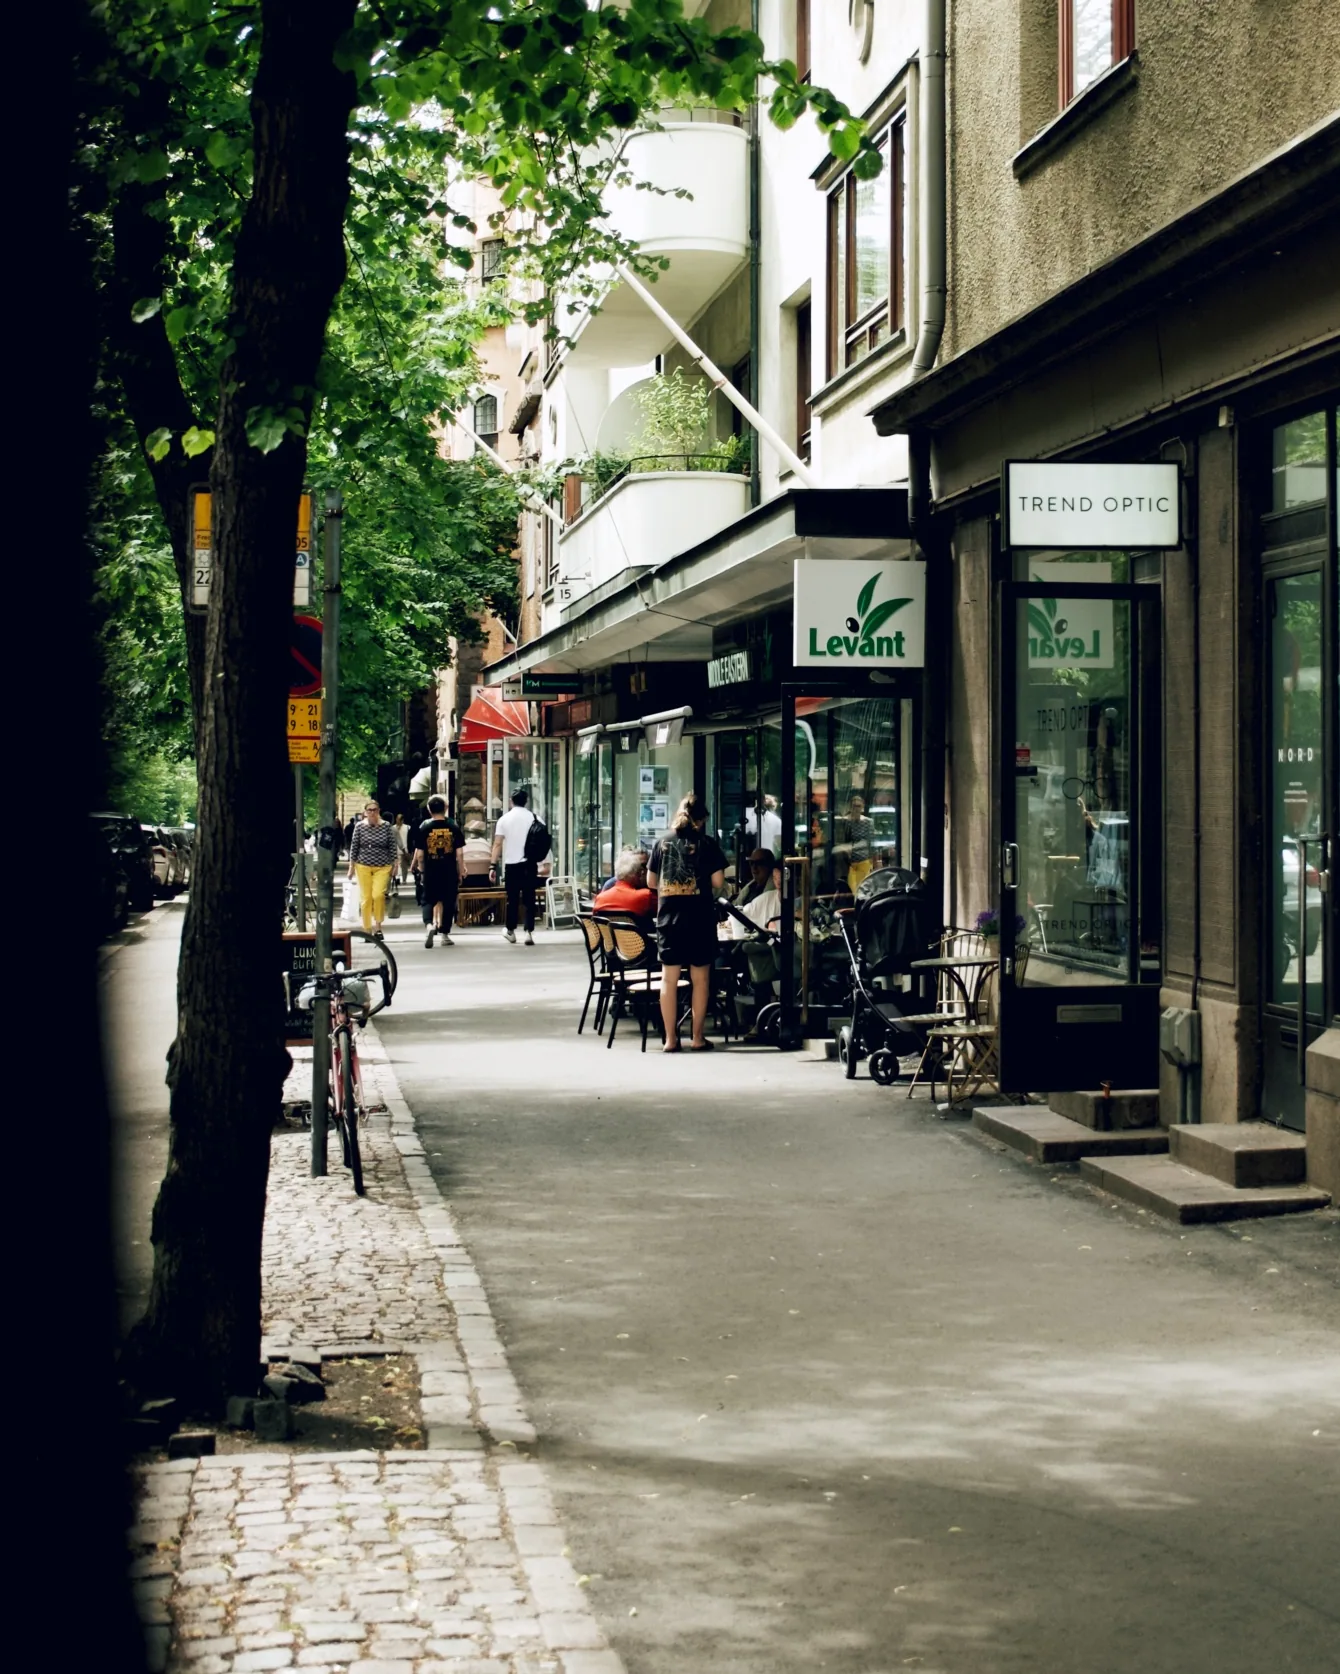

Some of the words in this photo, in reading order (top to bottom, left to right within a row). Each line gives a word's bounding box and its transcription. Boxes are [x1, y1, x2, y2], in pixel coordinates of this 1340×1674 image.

[1019, 496, 1093, 512] TREND
[1103, 496, 1169, 512] OPTIC
[809, 627, 905, 658] Levant
[308, 704, 318, 716] 21
